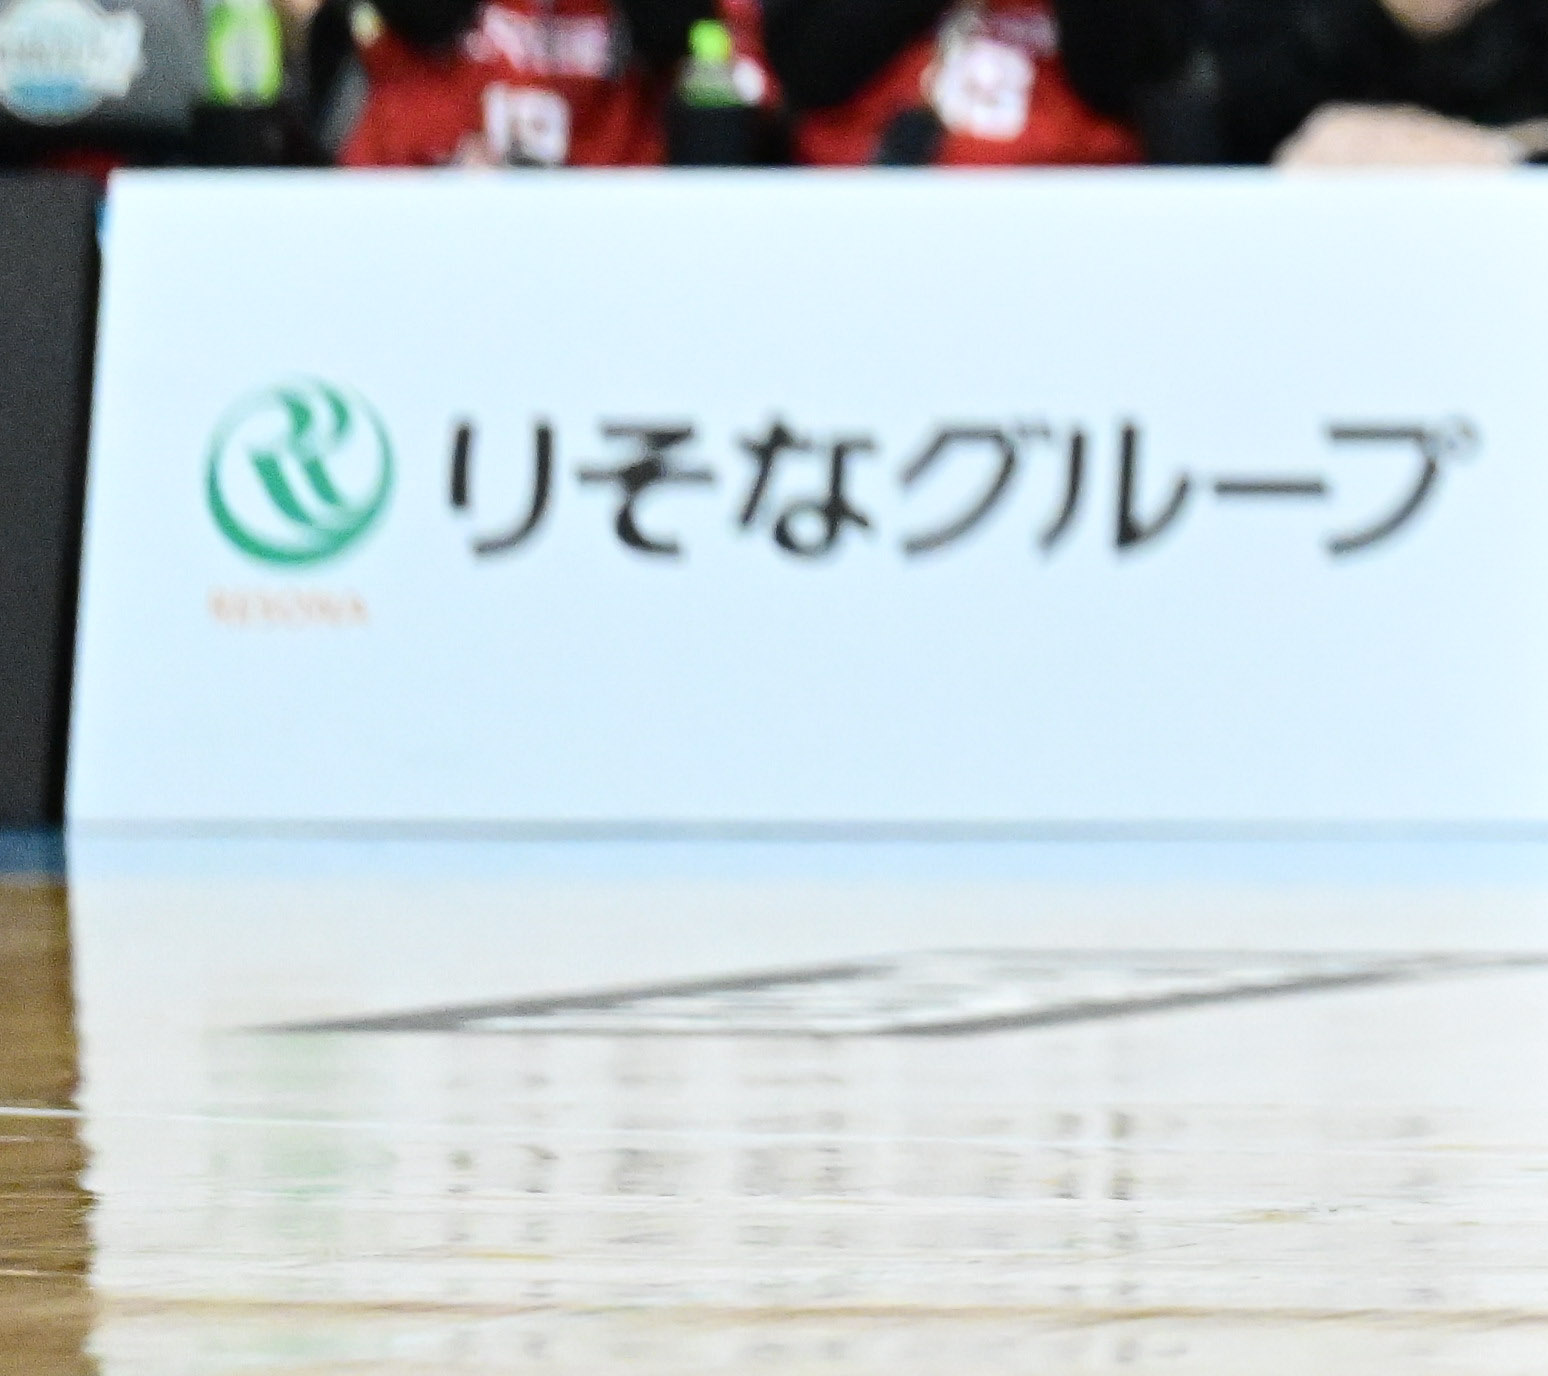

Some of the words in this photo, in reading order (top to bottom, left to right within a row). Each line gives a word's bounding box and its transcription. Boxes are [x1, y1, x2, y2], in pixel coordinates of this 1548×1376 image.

[446, 413, 1480, 560] りそなグループ
